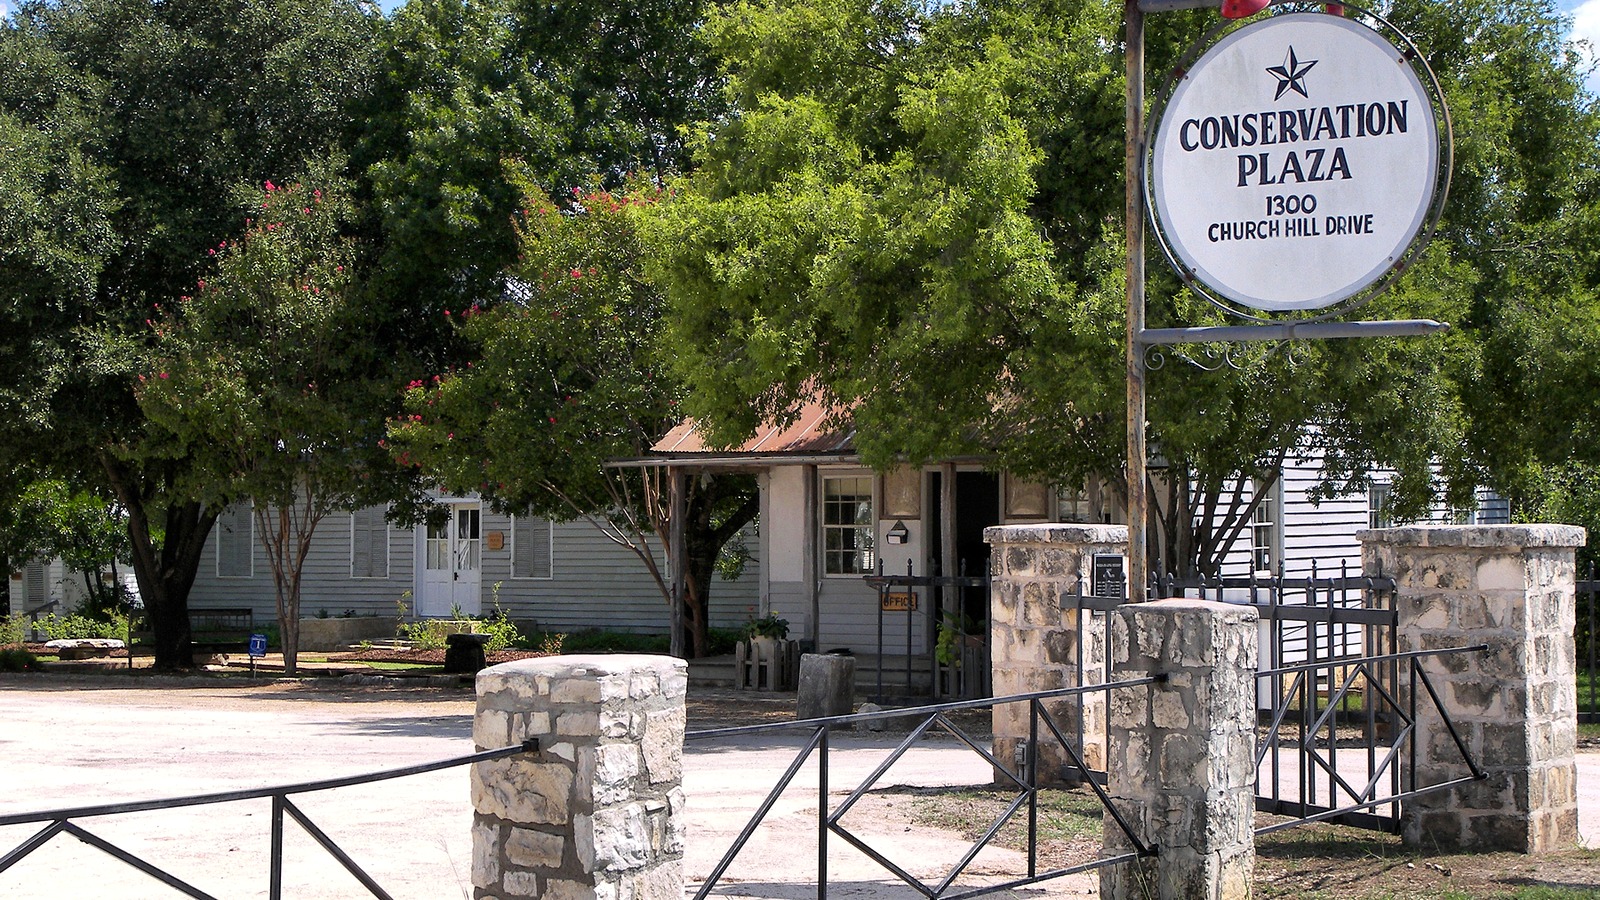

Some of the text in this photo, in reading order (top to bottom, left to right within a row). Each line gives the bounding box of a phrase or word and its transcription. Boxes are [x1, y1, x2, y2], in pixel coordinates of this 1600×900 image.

[1179, 100, 1408, 151] CONSERVATION
[1236, 147, 1353, 187] PLAZA
[1266, 194, 1317, 216] 1300
[1207, 214, 1374, 242] CHURCH HILL DRIVE
